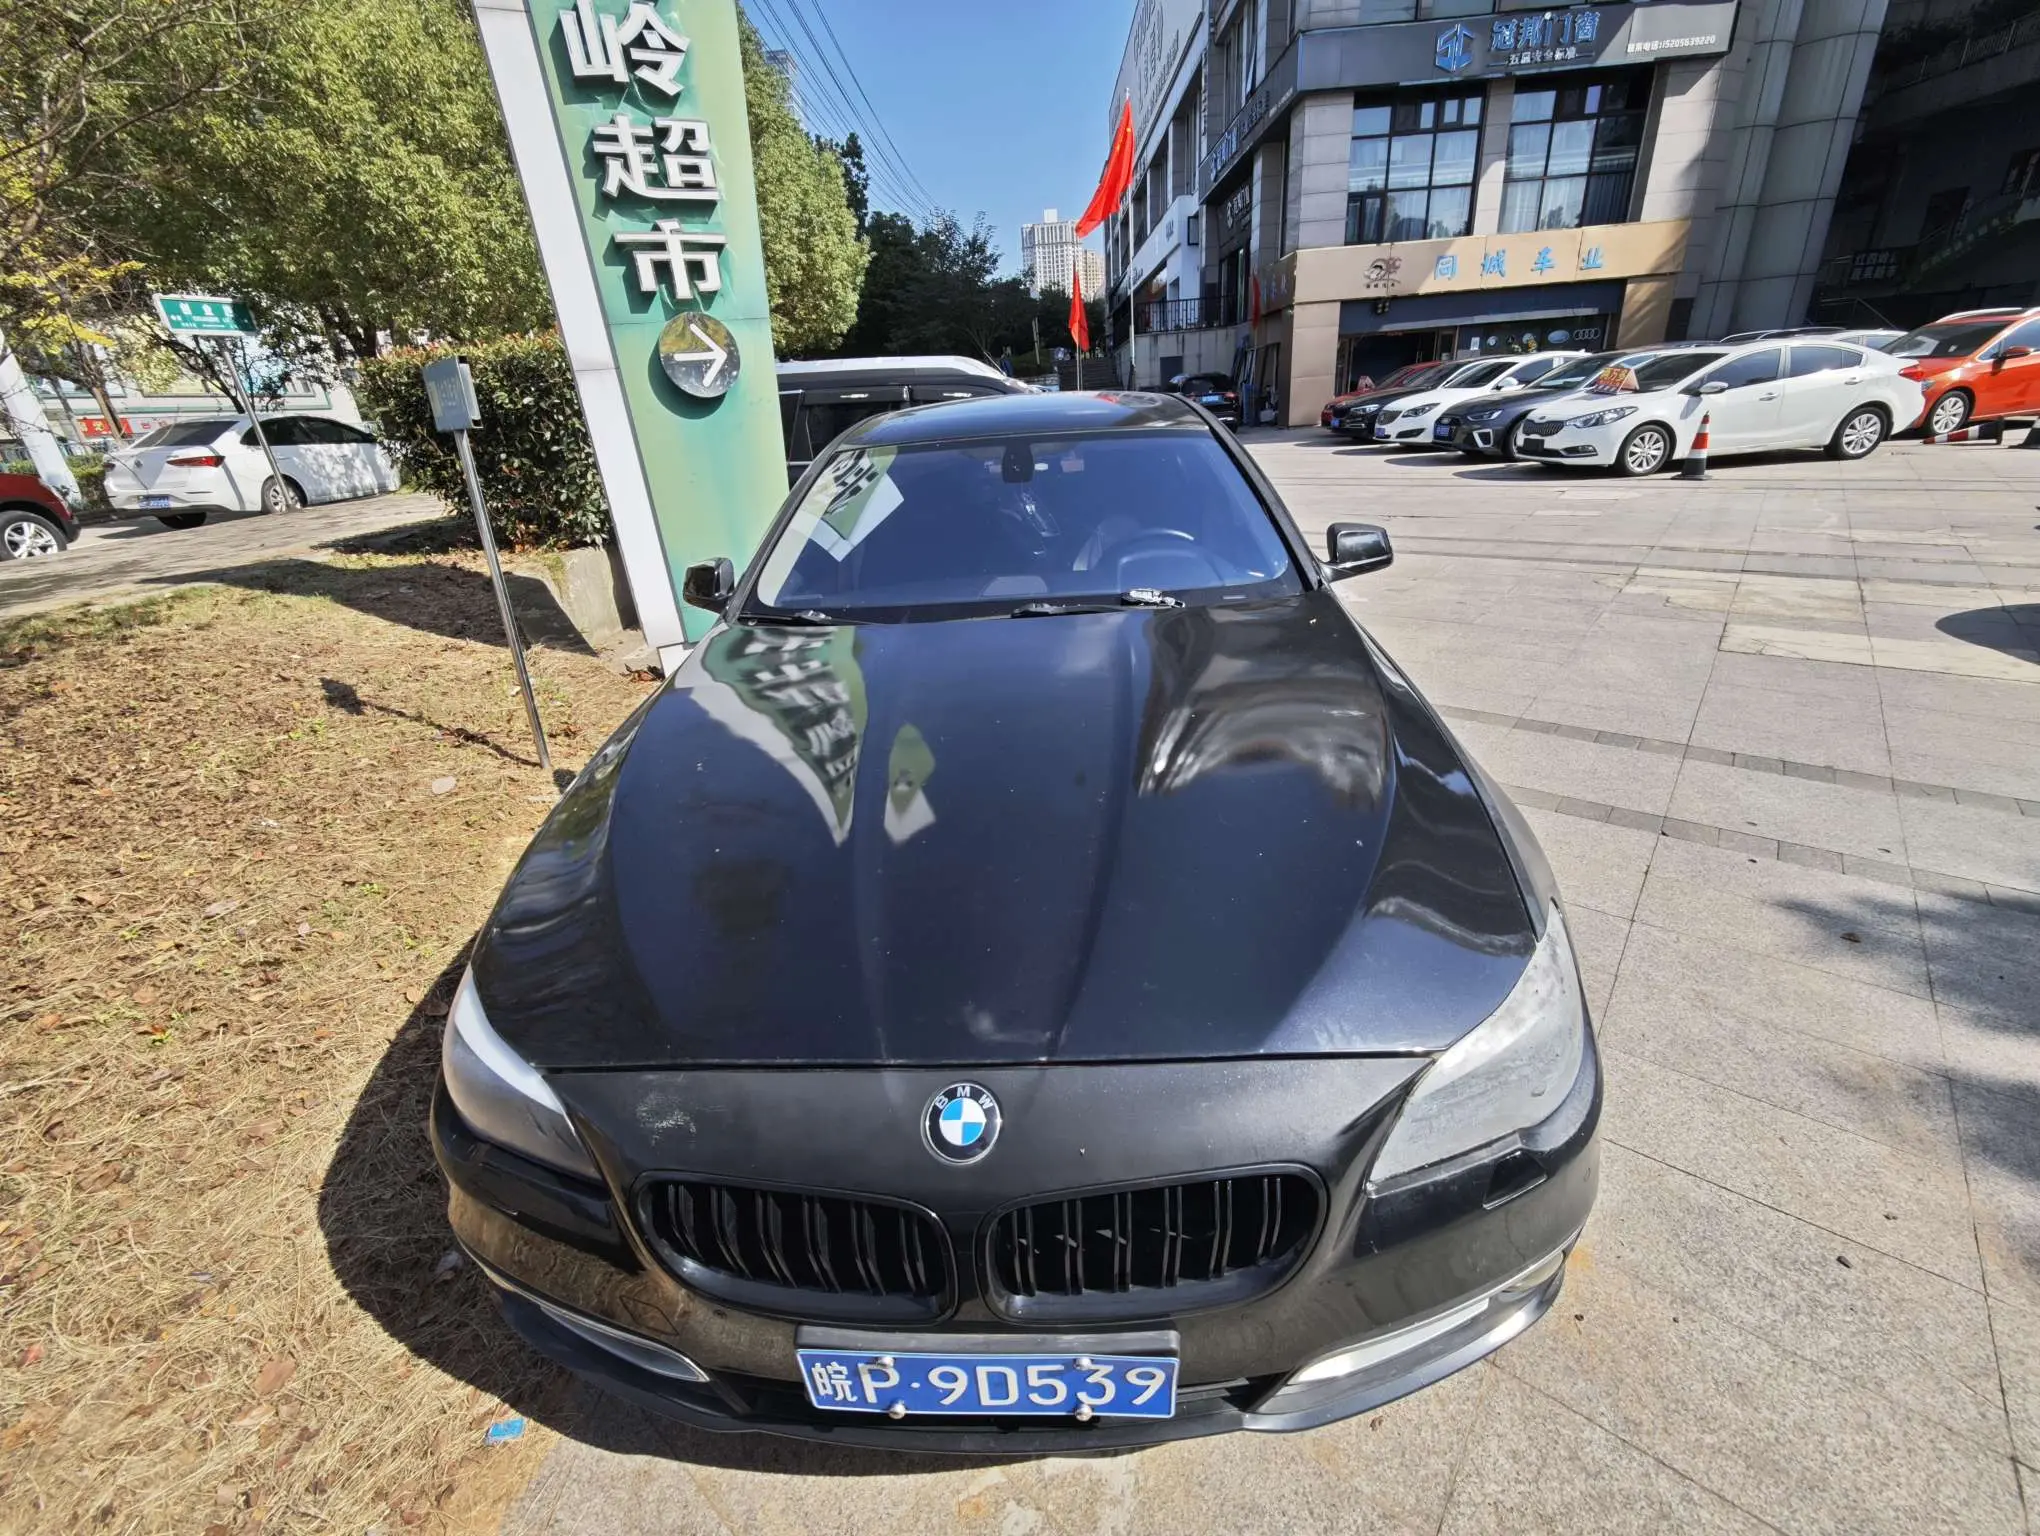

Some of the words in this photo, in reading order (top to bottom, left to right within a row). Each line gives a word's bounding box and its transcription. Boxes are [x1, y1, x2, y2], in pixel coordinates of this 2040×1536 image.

[559, 0, 728, 299] 岭超市
[1434, 246, 1605, 281] 同城车业
[935, 1086, 994, 1110] BMW
